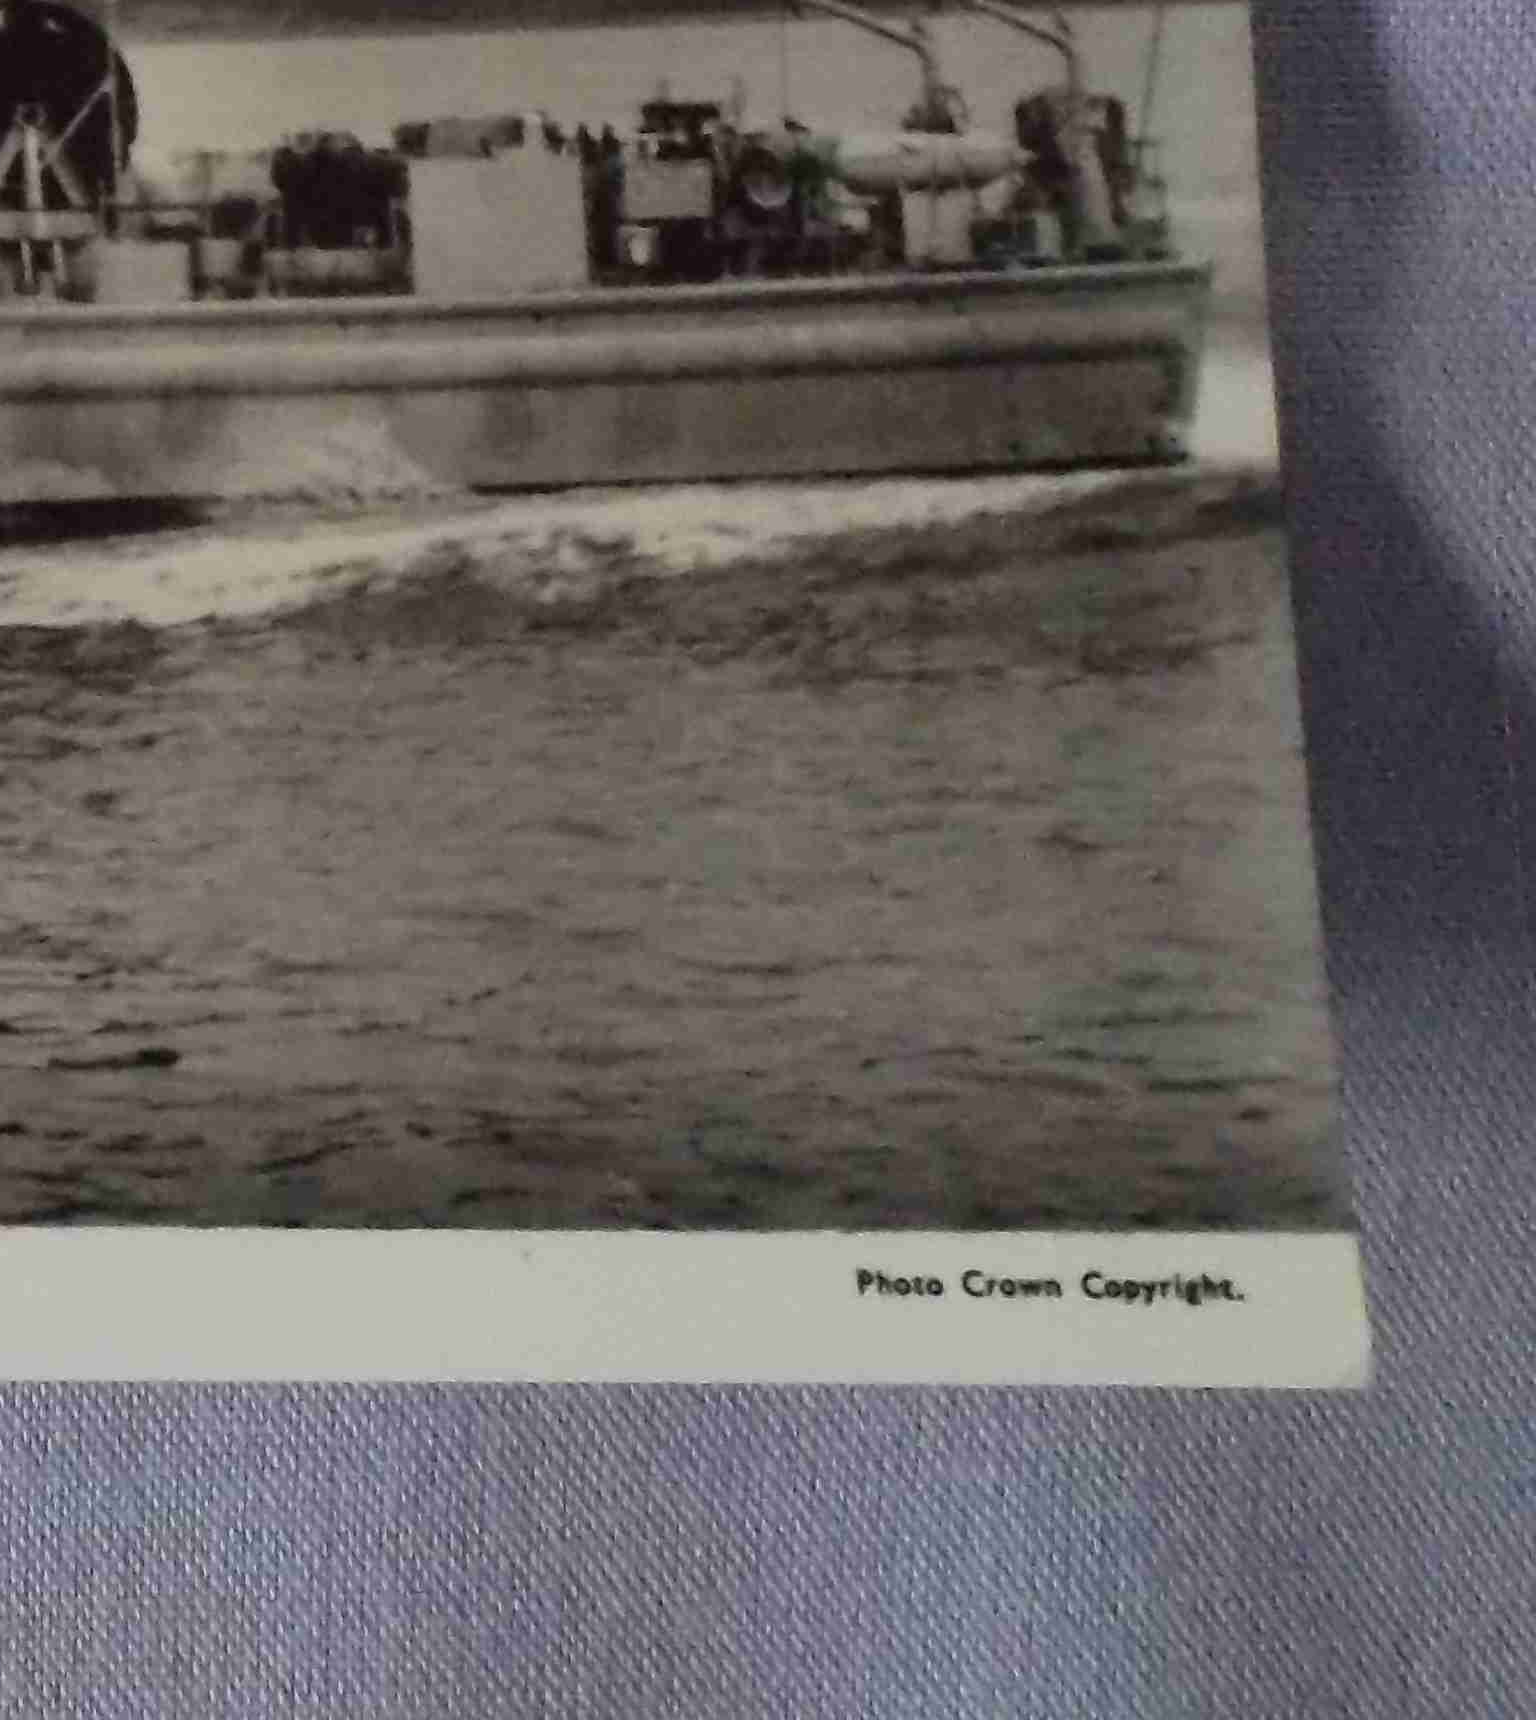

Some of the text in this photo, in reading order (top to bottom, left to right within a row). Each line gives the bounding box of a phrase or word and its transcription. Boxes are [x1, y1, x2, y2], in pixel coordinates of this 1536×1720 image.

[856, 1268, 1246, 1306] Photo Crown Copyright.
